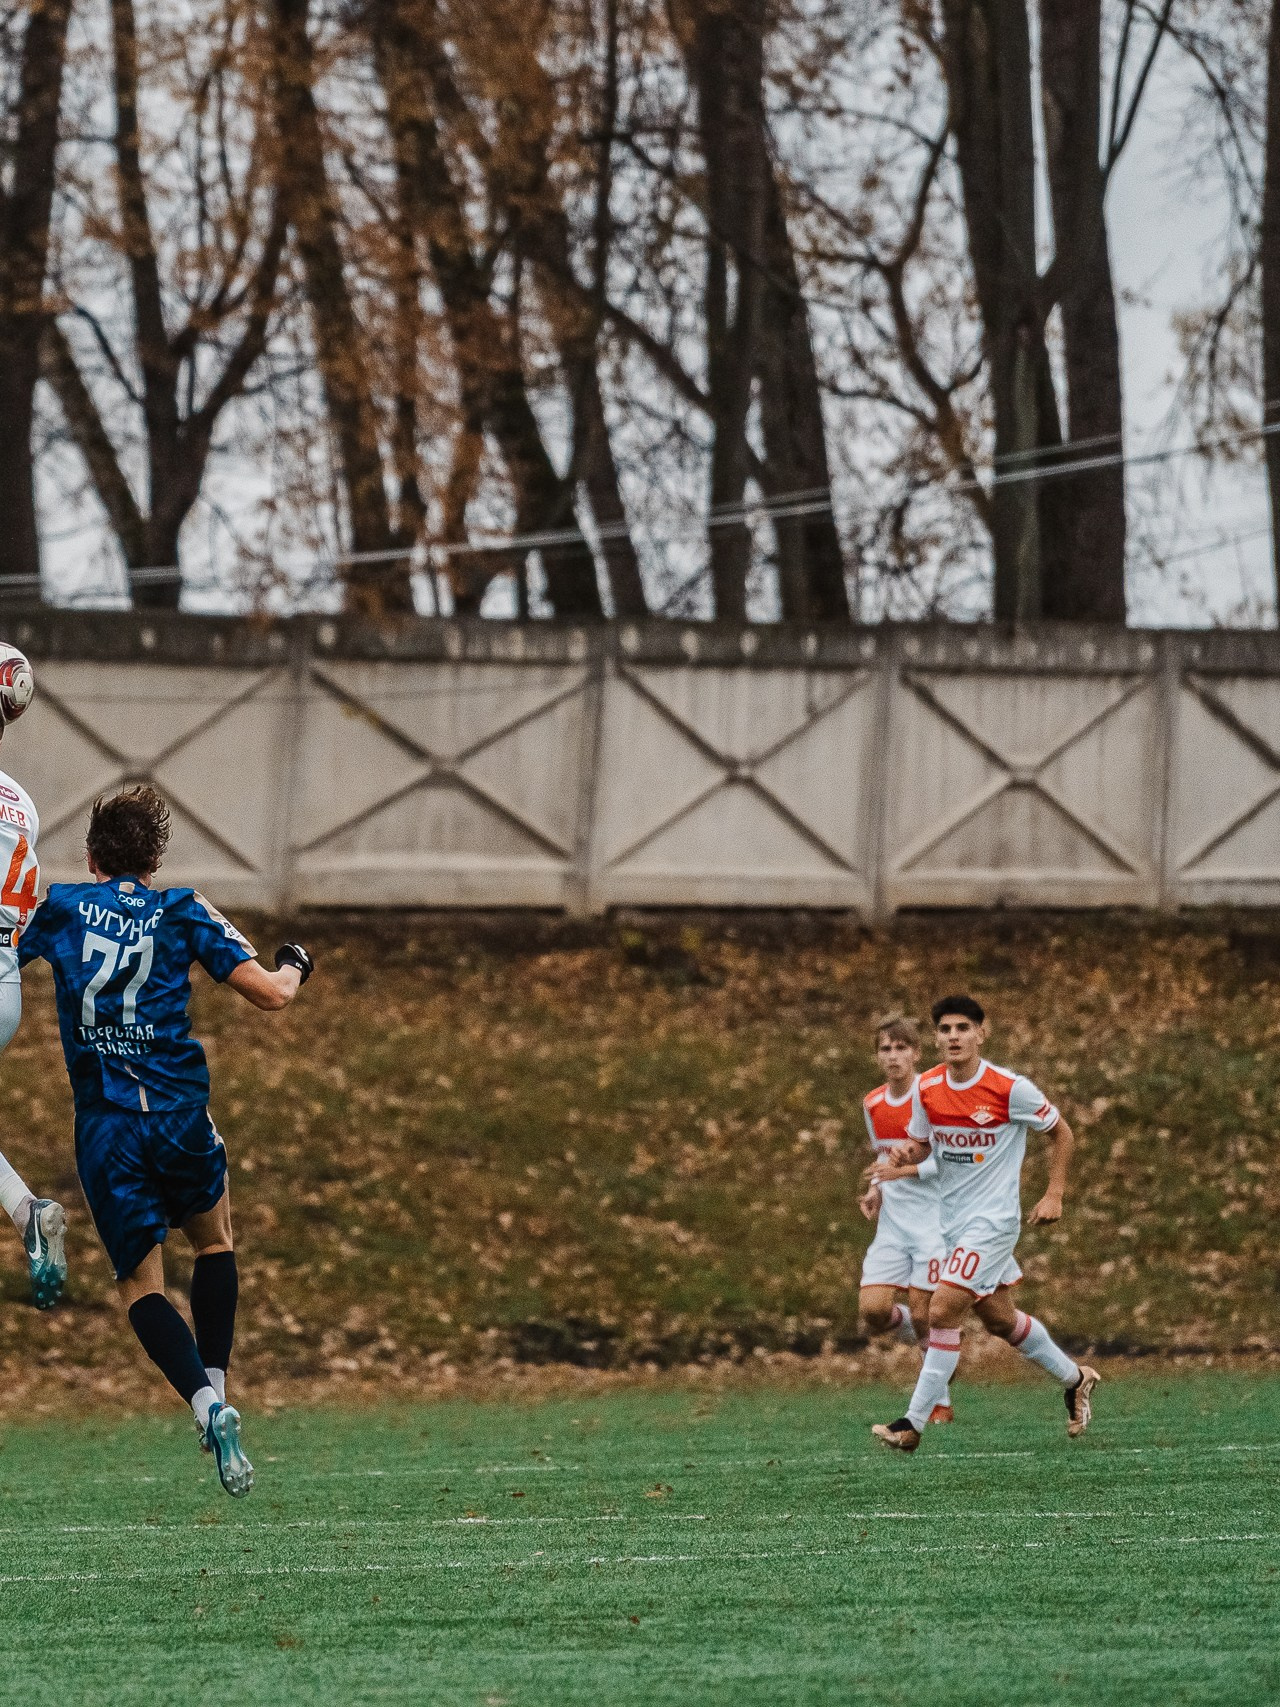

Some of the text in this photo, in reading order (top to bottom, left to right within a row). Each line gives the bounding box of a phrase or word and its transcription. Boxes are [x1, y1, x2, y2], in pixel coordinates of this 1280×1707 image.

[118, 894, 146, 908] core
[82, 931, 154, 1027] 77
[78, 1024, 155, 1041] ТВЕРСКАЯ
[949, 1247, 980, 1281] 60
